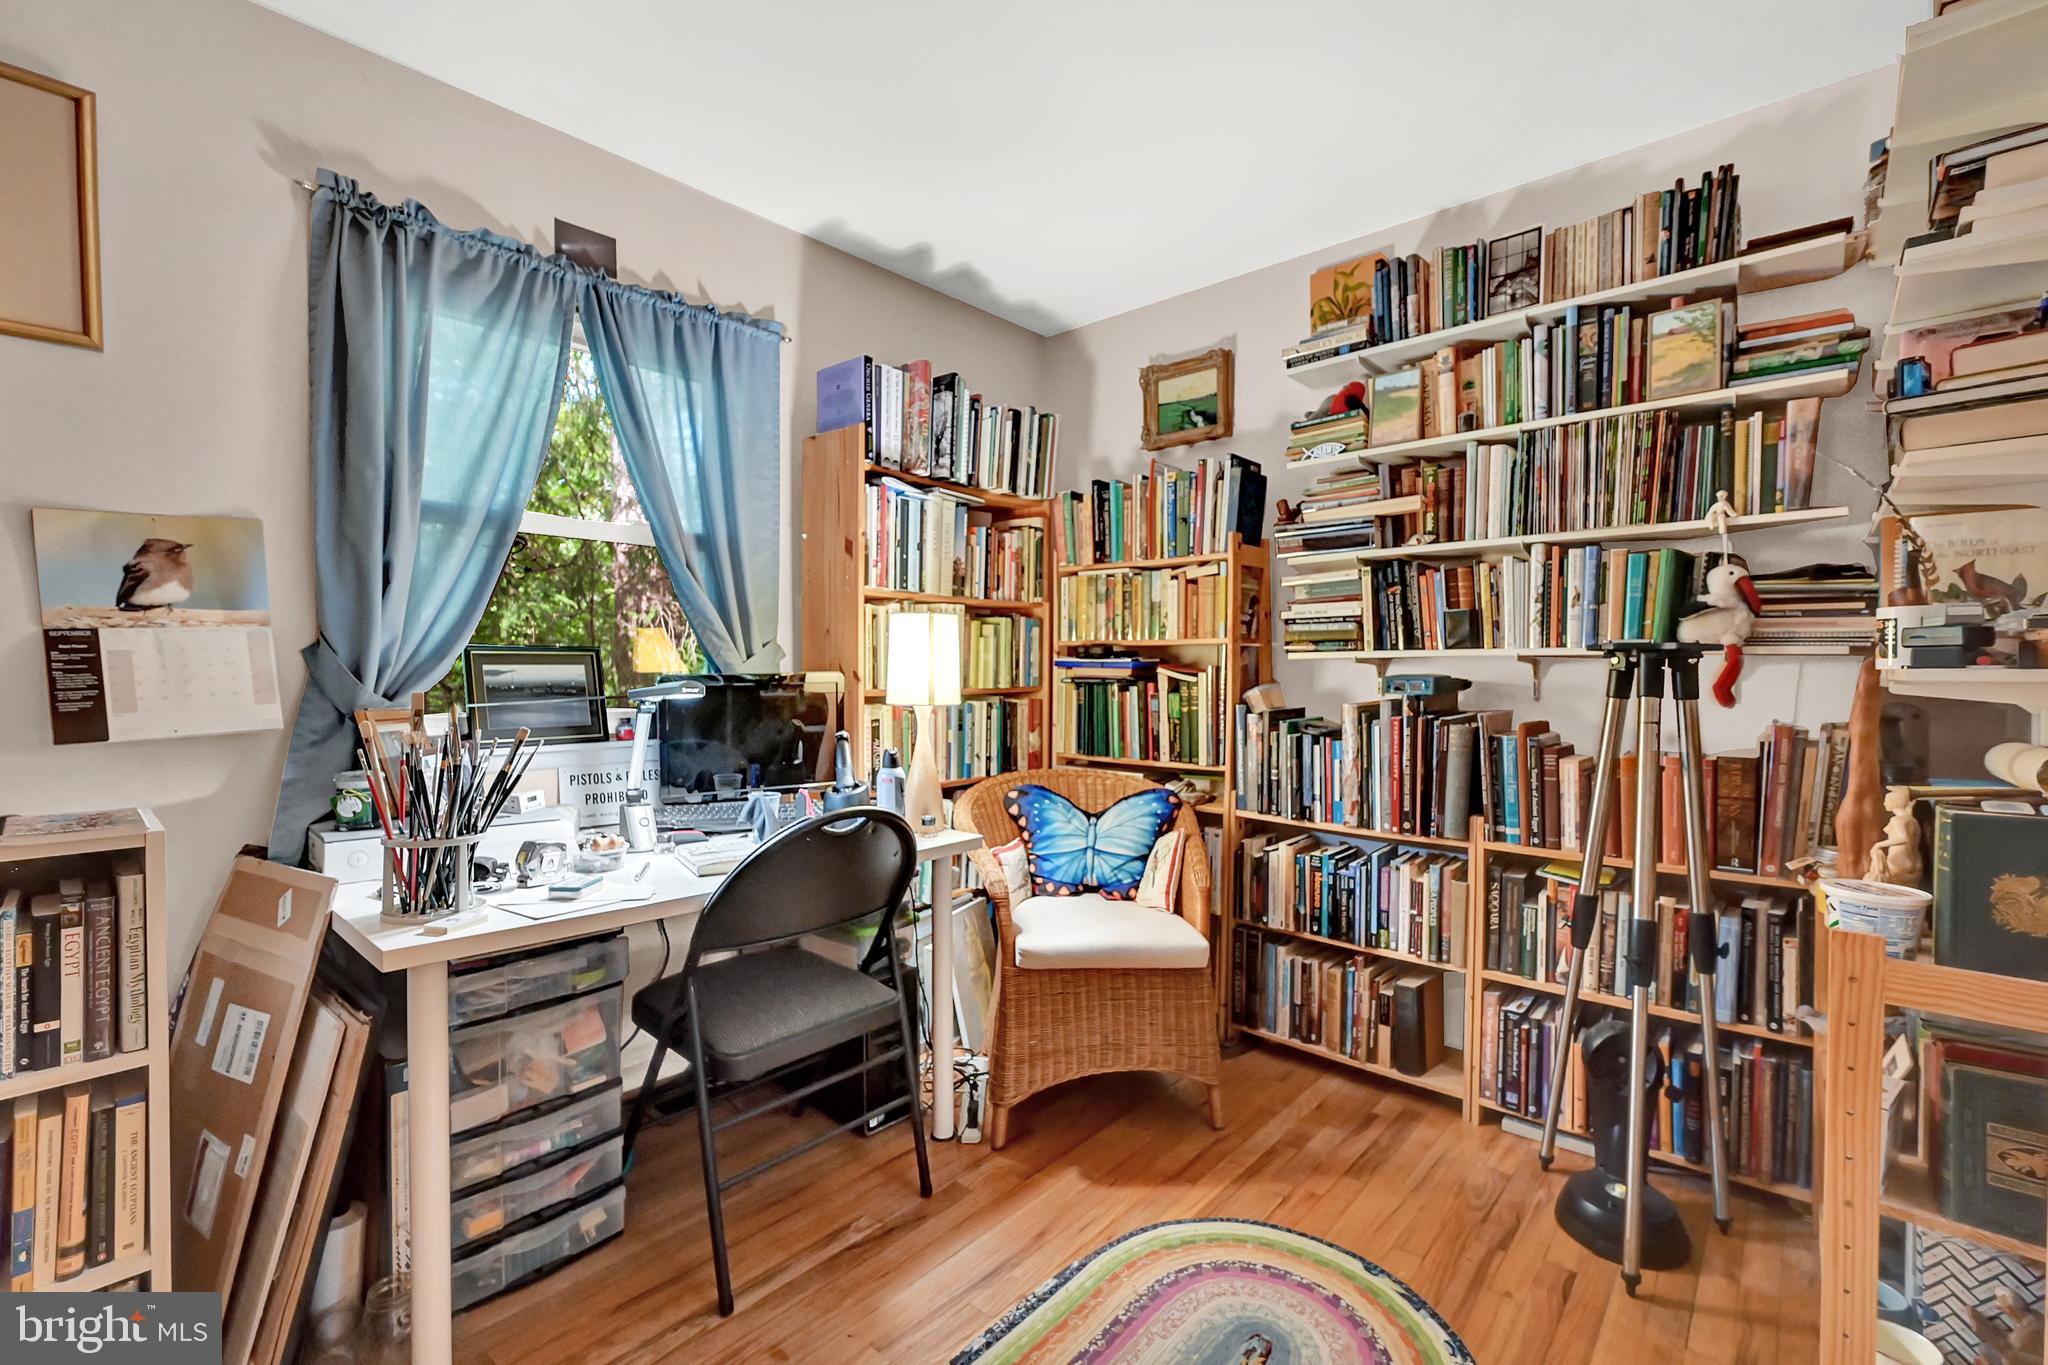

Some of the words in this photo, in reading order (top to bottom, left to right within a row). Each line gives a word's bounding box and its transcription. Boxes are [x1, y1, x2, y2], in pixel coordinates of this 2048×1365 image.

[1948, 537, 1985, 548] BIRDS
[1954, 546, 2035, 558] NORTHEAST
[569, 772, 612, 786] PISTOLS
[615, 773, 623, 781] &
[626, 769, 659, 782] LES
[585, 789, 648, 805] PROHIBD
[1531, 796, 1539, 816] Ancient
[1489, 881, 1499, 930] SAQQARA
[64, 933, 81, 977] EGYPT
[95, 916, 111, 973] ANCIENT
[126, 926, 144, 970] Egyptian
[95, 978, 111, 1024] EGYPT
[126, 972, 145, 1025] Mythology
[70, 1128, 79, 1156] EGYPT
[130, 1131, 138, 1146] THE
[130, 1150, 138, 1181] ANCIENT
[129, 1183, 138, 1225] EGYPTIANS
